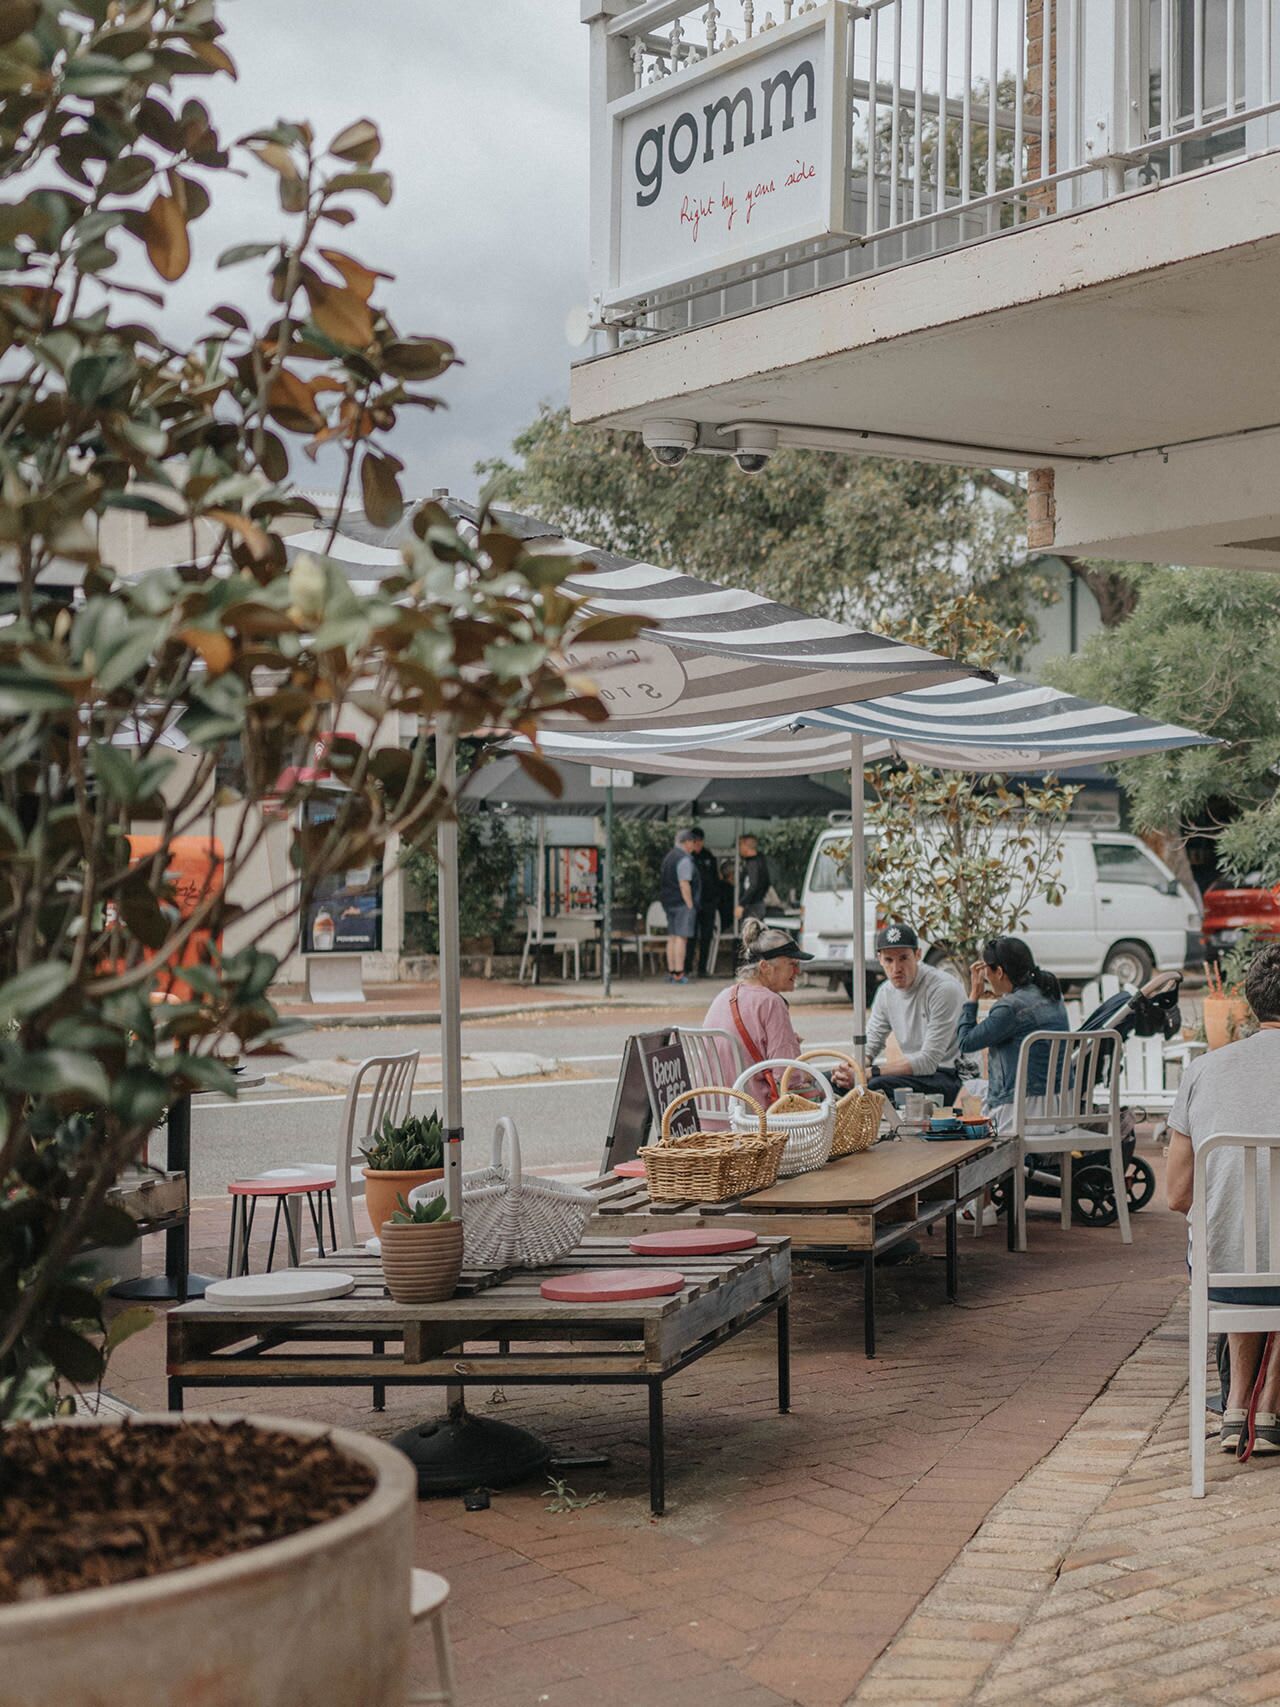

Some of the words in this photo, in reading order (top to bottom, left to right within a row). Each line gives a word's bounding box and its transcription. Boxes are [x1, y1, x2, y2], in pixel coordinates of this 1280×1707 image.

[635, 59, 818, 207] gomm
[680, 195, 716, 242] Right
[721, 181, 737, 230] by
[785, 159, 816, 190] side
[652, 1056, 682, 1090] Bacon
